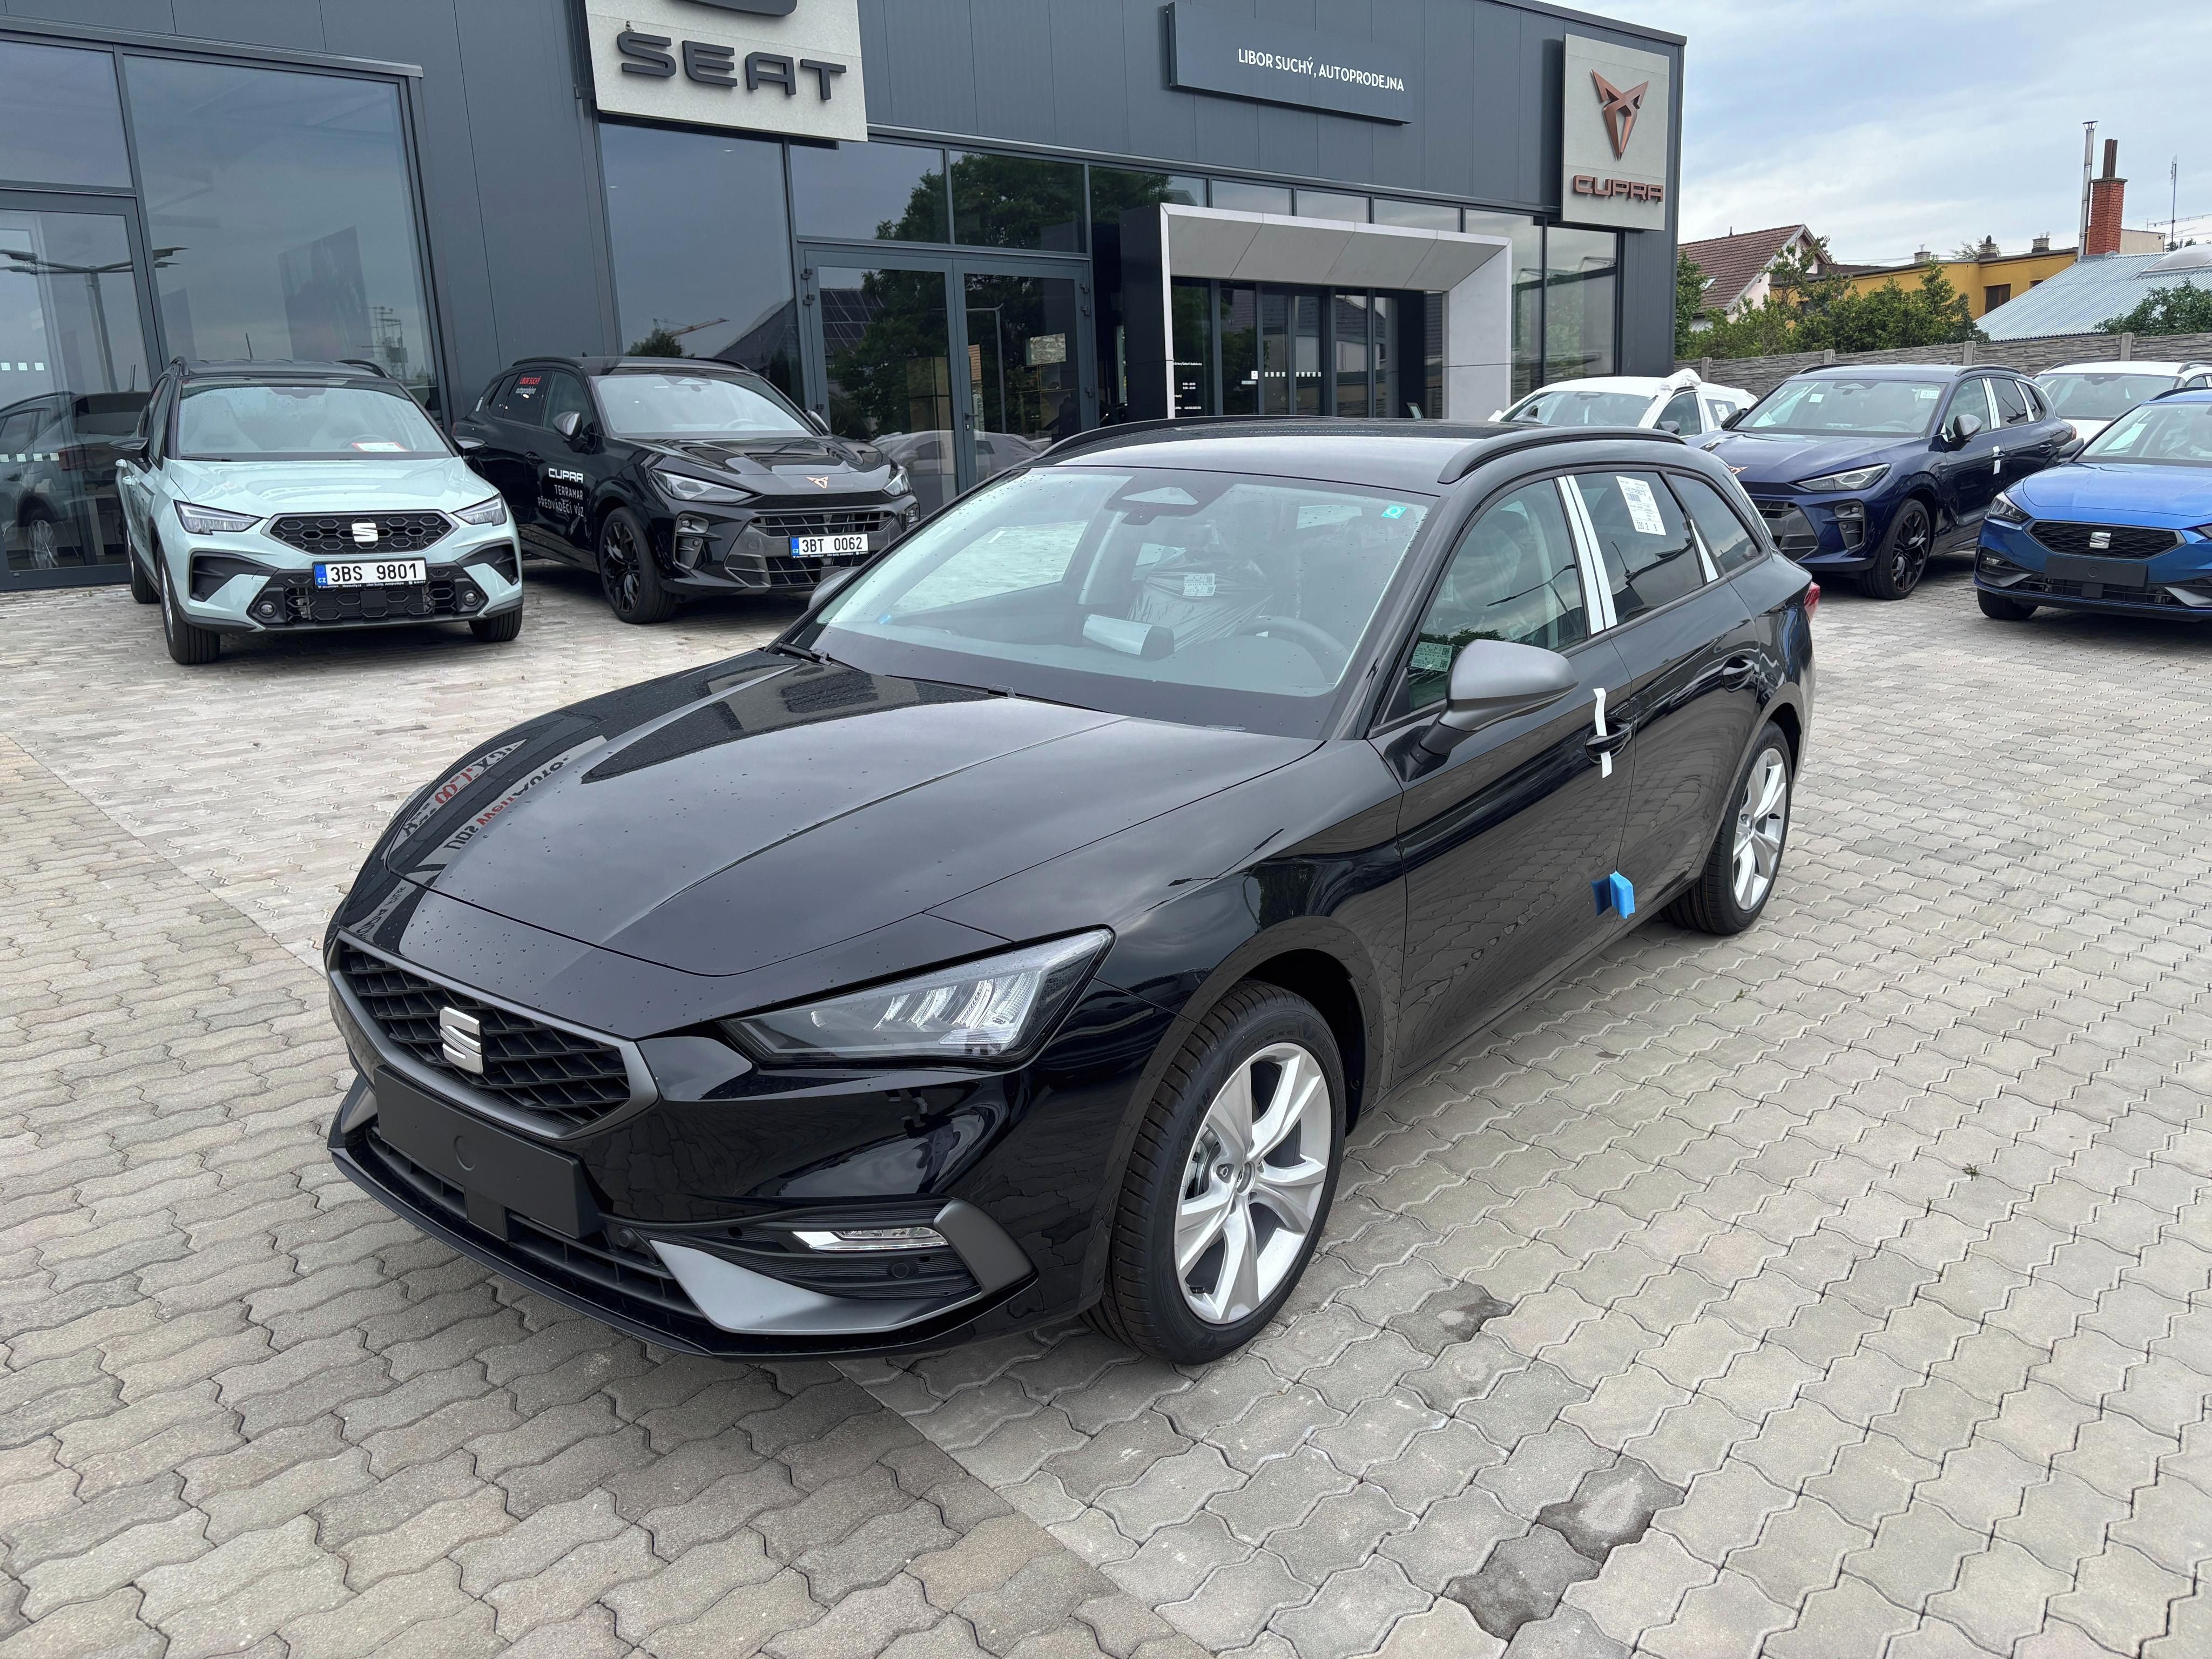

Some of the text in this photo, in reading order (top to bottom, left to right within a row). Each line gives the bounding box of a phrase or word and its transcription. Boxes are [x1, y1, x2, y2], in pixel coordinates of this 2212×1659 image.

[617, 31, 846, 100] SEAT
[1238, 48, 1405, 92] LIBOR SUCHÝ, AUTOPRODEJNA
[1573, 174, 1664, 203] CUPRA
[548, 468, 583, 483] CUPRA
[554, 484, 583, 501] TERRAMAR
[802, 538, 824, 552] 3BT
[834, 537, 862, 551] 0062
[331, 565, 363, 582] 3BS
[376, 563, 416, 580] 9801
